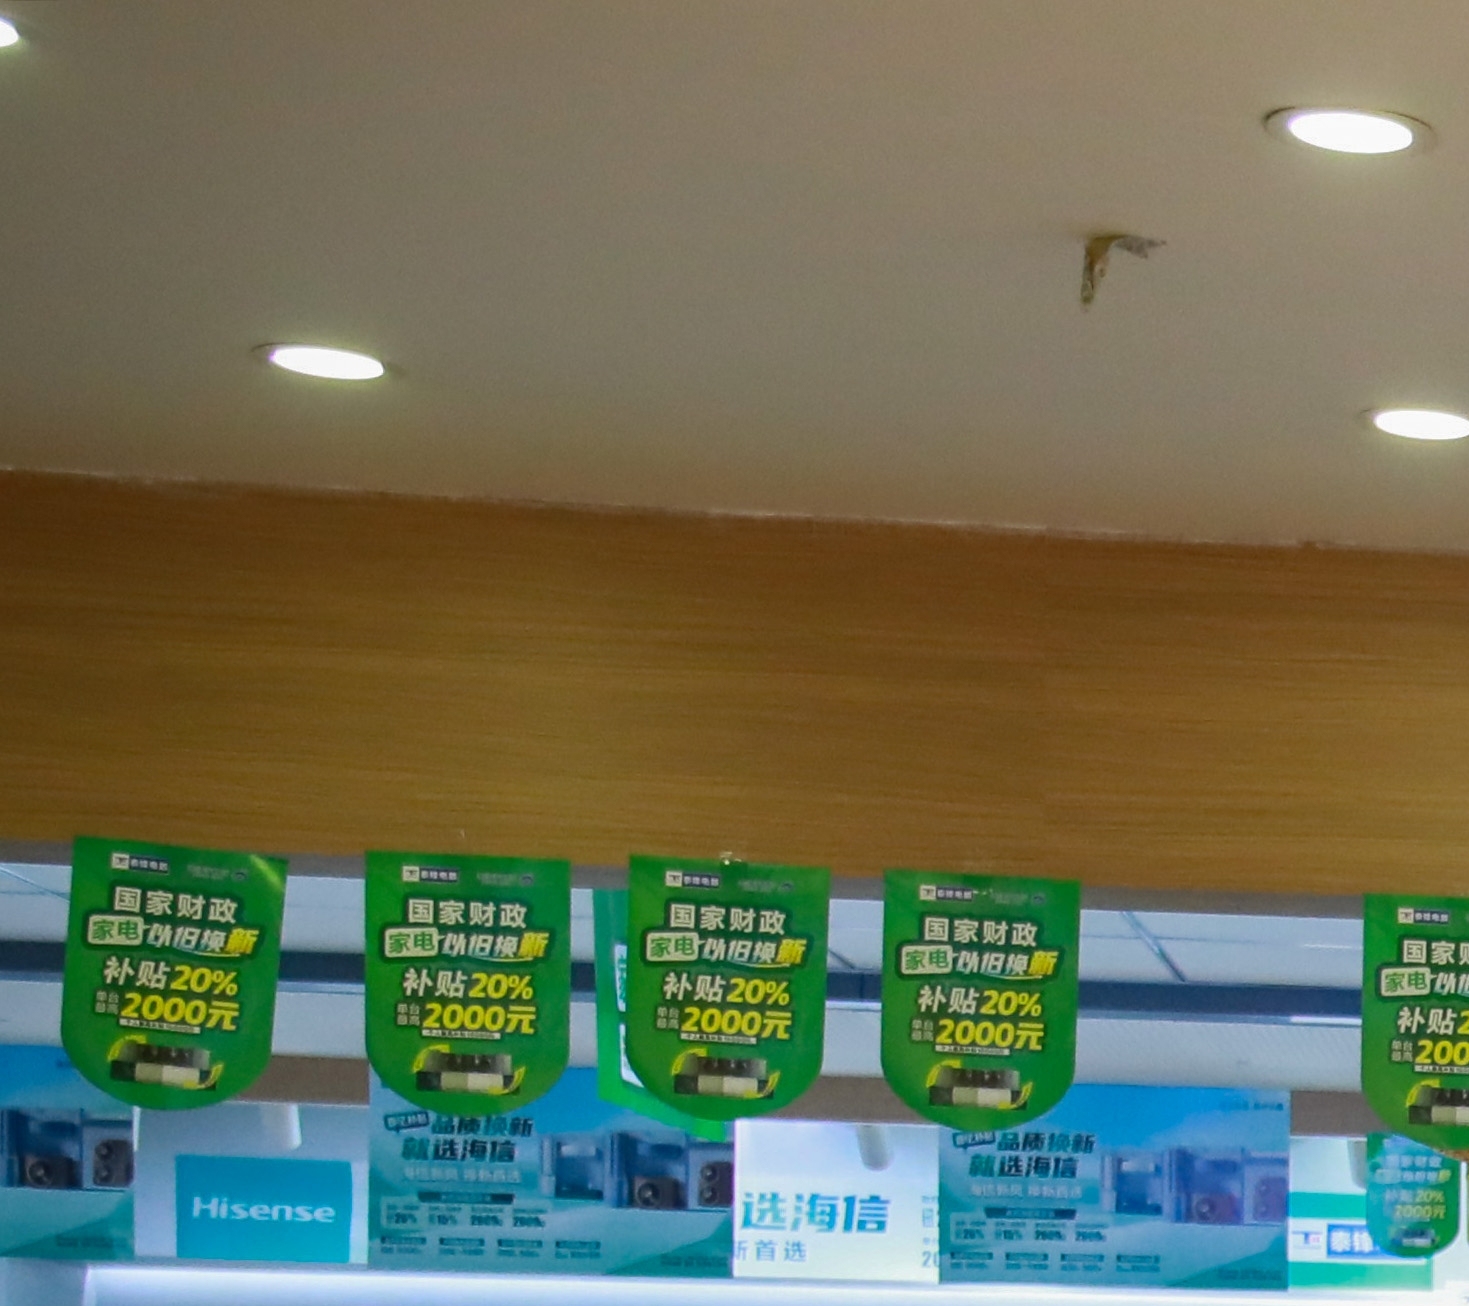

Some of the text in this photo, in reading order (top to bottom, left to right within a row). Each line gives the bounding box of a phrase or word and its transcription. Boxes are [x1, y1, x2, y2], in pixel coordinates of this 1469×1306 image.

[114, 886, 238, 924] 国家财政
[409, 898, 527, 928] 国家财政
[670, 903, 786, 935] 国家财政
[925, 917, 1038, 947] 国家财政
[102, 955, 239, 996] 补贴20%
[403, 968, 533, 999] 补贴20%
[663, 972, 790, 1005] 补贴20%
[121, 992, 239, 1031] 2000元
[918, 985, 1042, 1016] 补贴20%
[423, 1003, 536, 1034] 2000元
[681, 1007, 792, 1040] 2000元
[936, 1019, 1044, 1051] 2000元
[402, 1138, 517, 1162] 就选海信
[969, 1155, 1079, 1178] 就选海信
[192, 1197, 335, 1222] Hisense
[740, 1192, 890, 1234] 选海信
